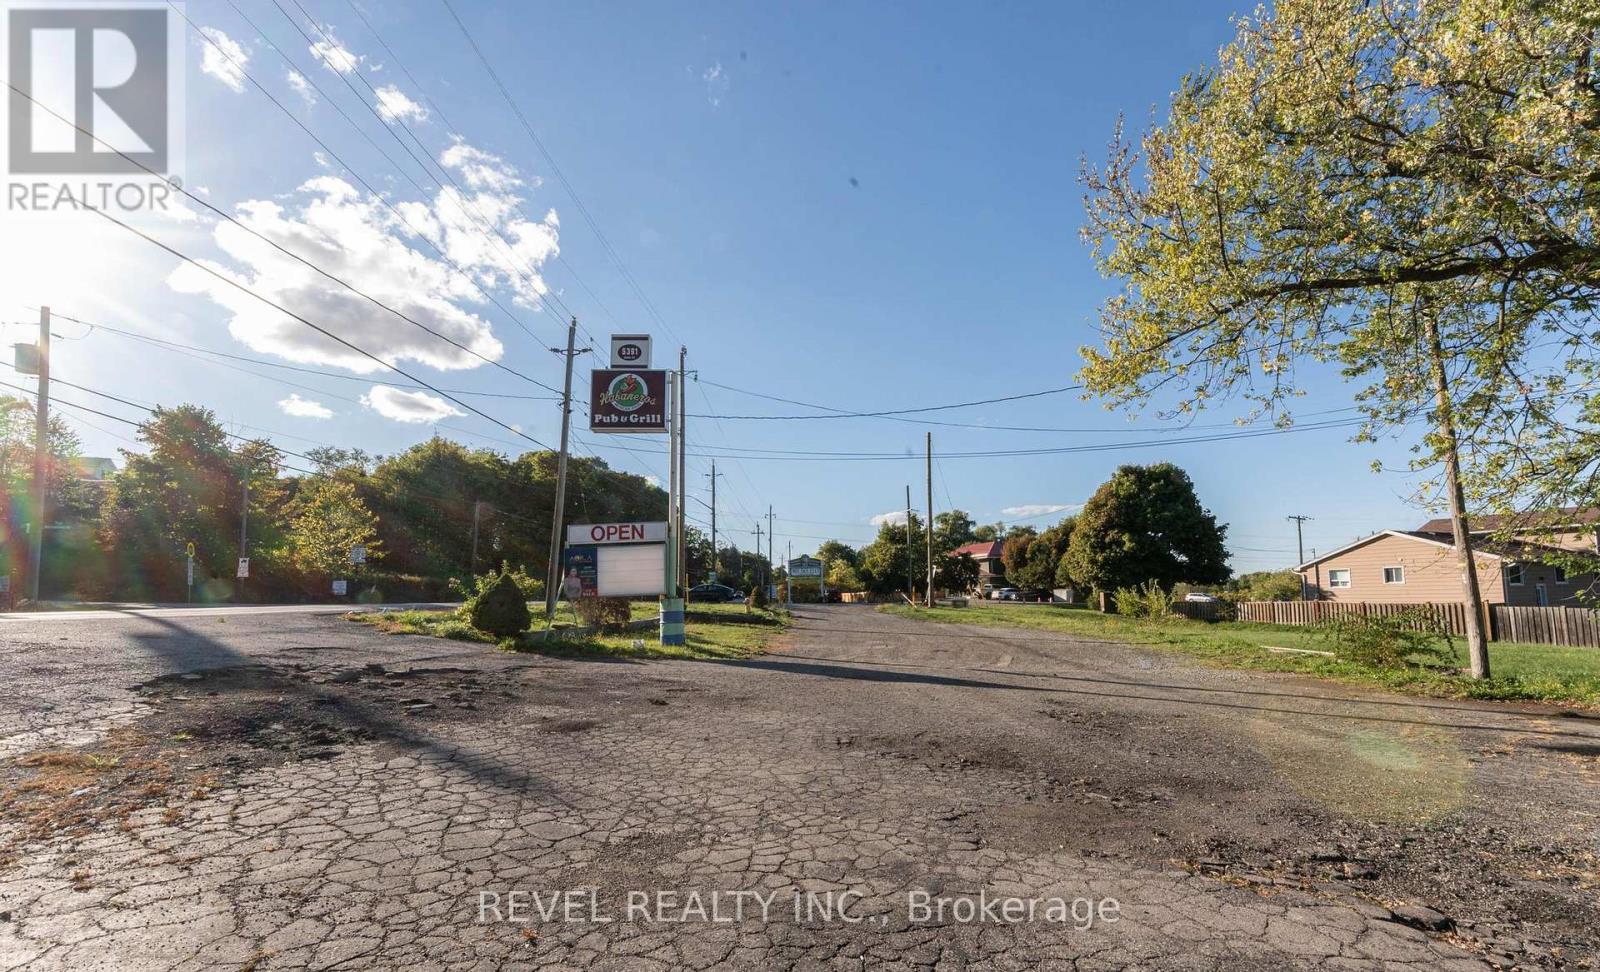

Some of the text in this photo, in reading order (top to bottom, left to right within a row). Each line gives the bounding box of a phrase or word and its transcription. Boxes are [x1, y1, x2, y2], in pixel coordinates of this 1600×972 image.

[594, 414, 618, 423] Pub
[629, 414, 661, 423] Grill
[591, 525, 645, 541] OPEN
